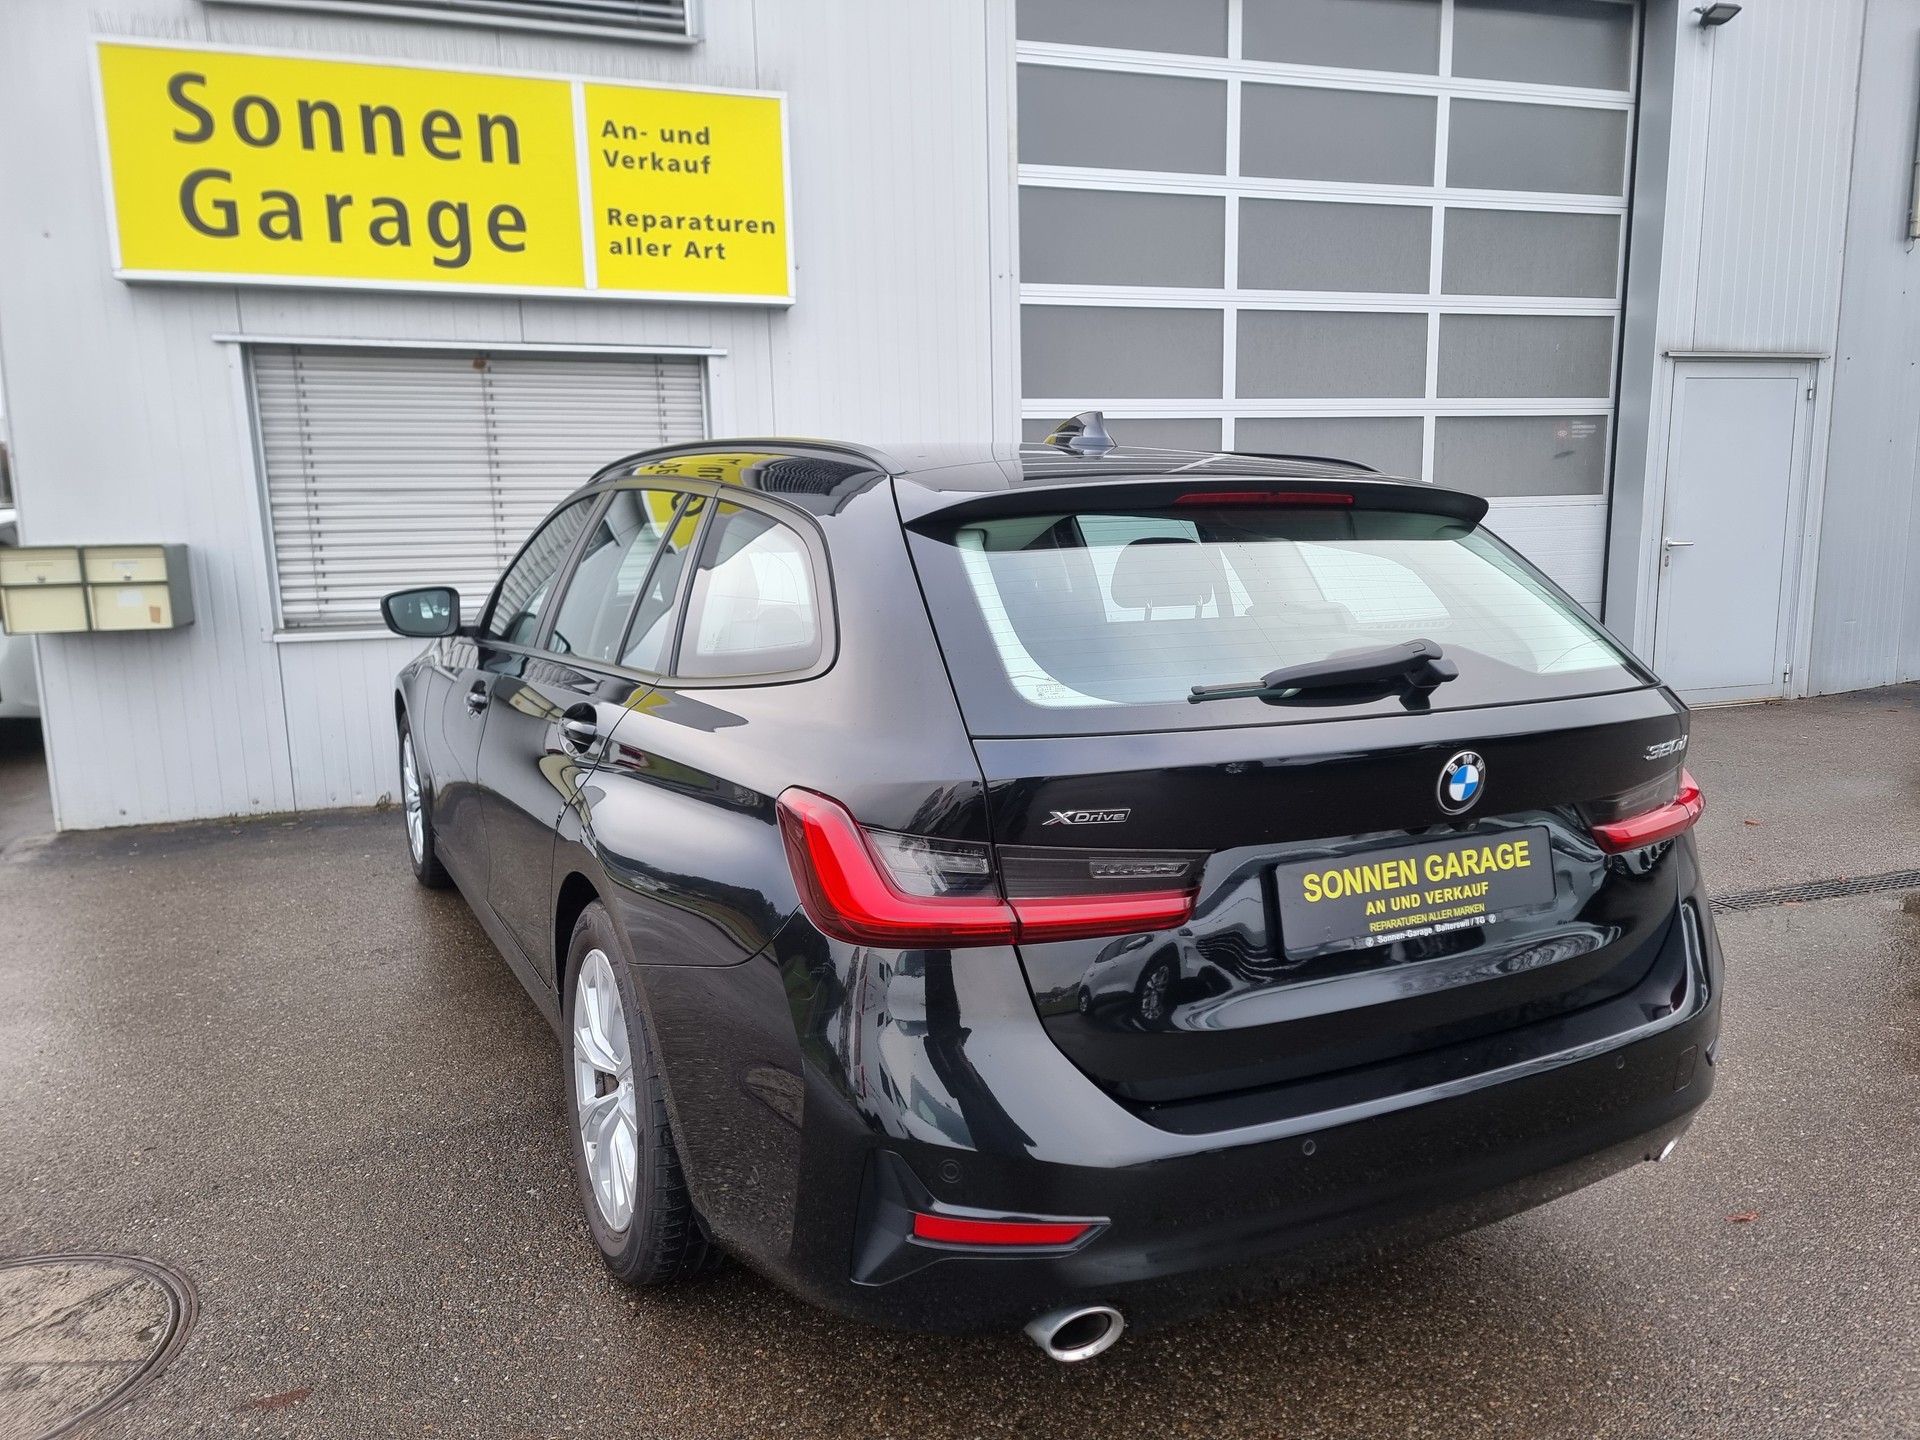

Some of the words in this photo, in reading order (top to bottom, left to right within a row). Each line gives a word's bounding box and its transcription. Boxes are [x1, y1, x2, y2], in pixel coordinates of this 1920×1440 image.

[168, 73, 520, 164] Sonnen
[602, 120, 647, 142] An-
[661, 126, 709, 146] und
[602, 149, 711, 174] Verkauf
[179, 169, 527, 268] Garage
[607, 208, 775, 234] Reparaturen
[610, 237, 671, 257] aller
[684, 242, 726, 260] Art
[1303, 857, 1419, 903] SONNEN
[1423, 840, 1531, 882] GARAGE
[1365, 900, 1386, 916] AN
[1390, 892, 1421, 911] UND
[1426, 881, 1489, 904] VERKAUF
[1369, 914, 1428, 932] REPARATUREN
[1428, 909, 1453, 922] ALLER
[1453, 903, 1485, 917] MARKEN
[1377, 926, 1433, 943] Sonnen-Garage
